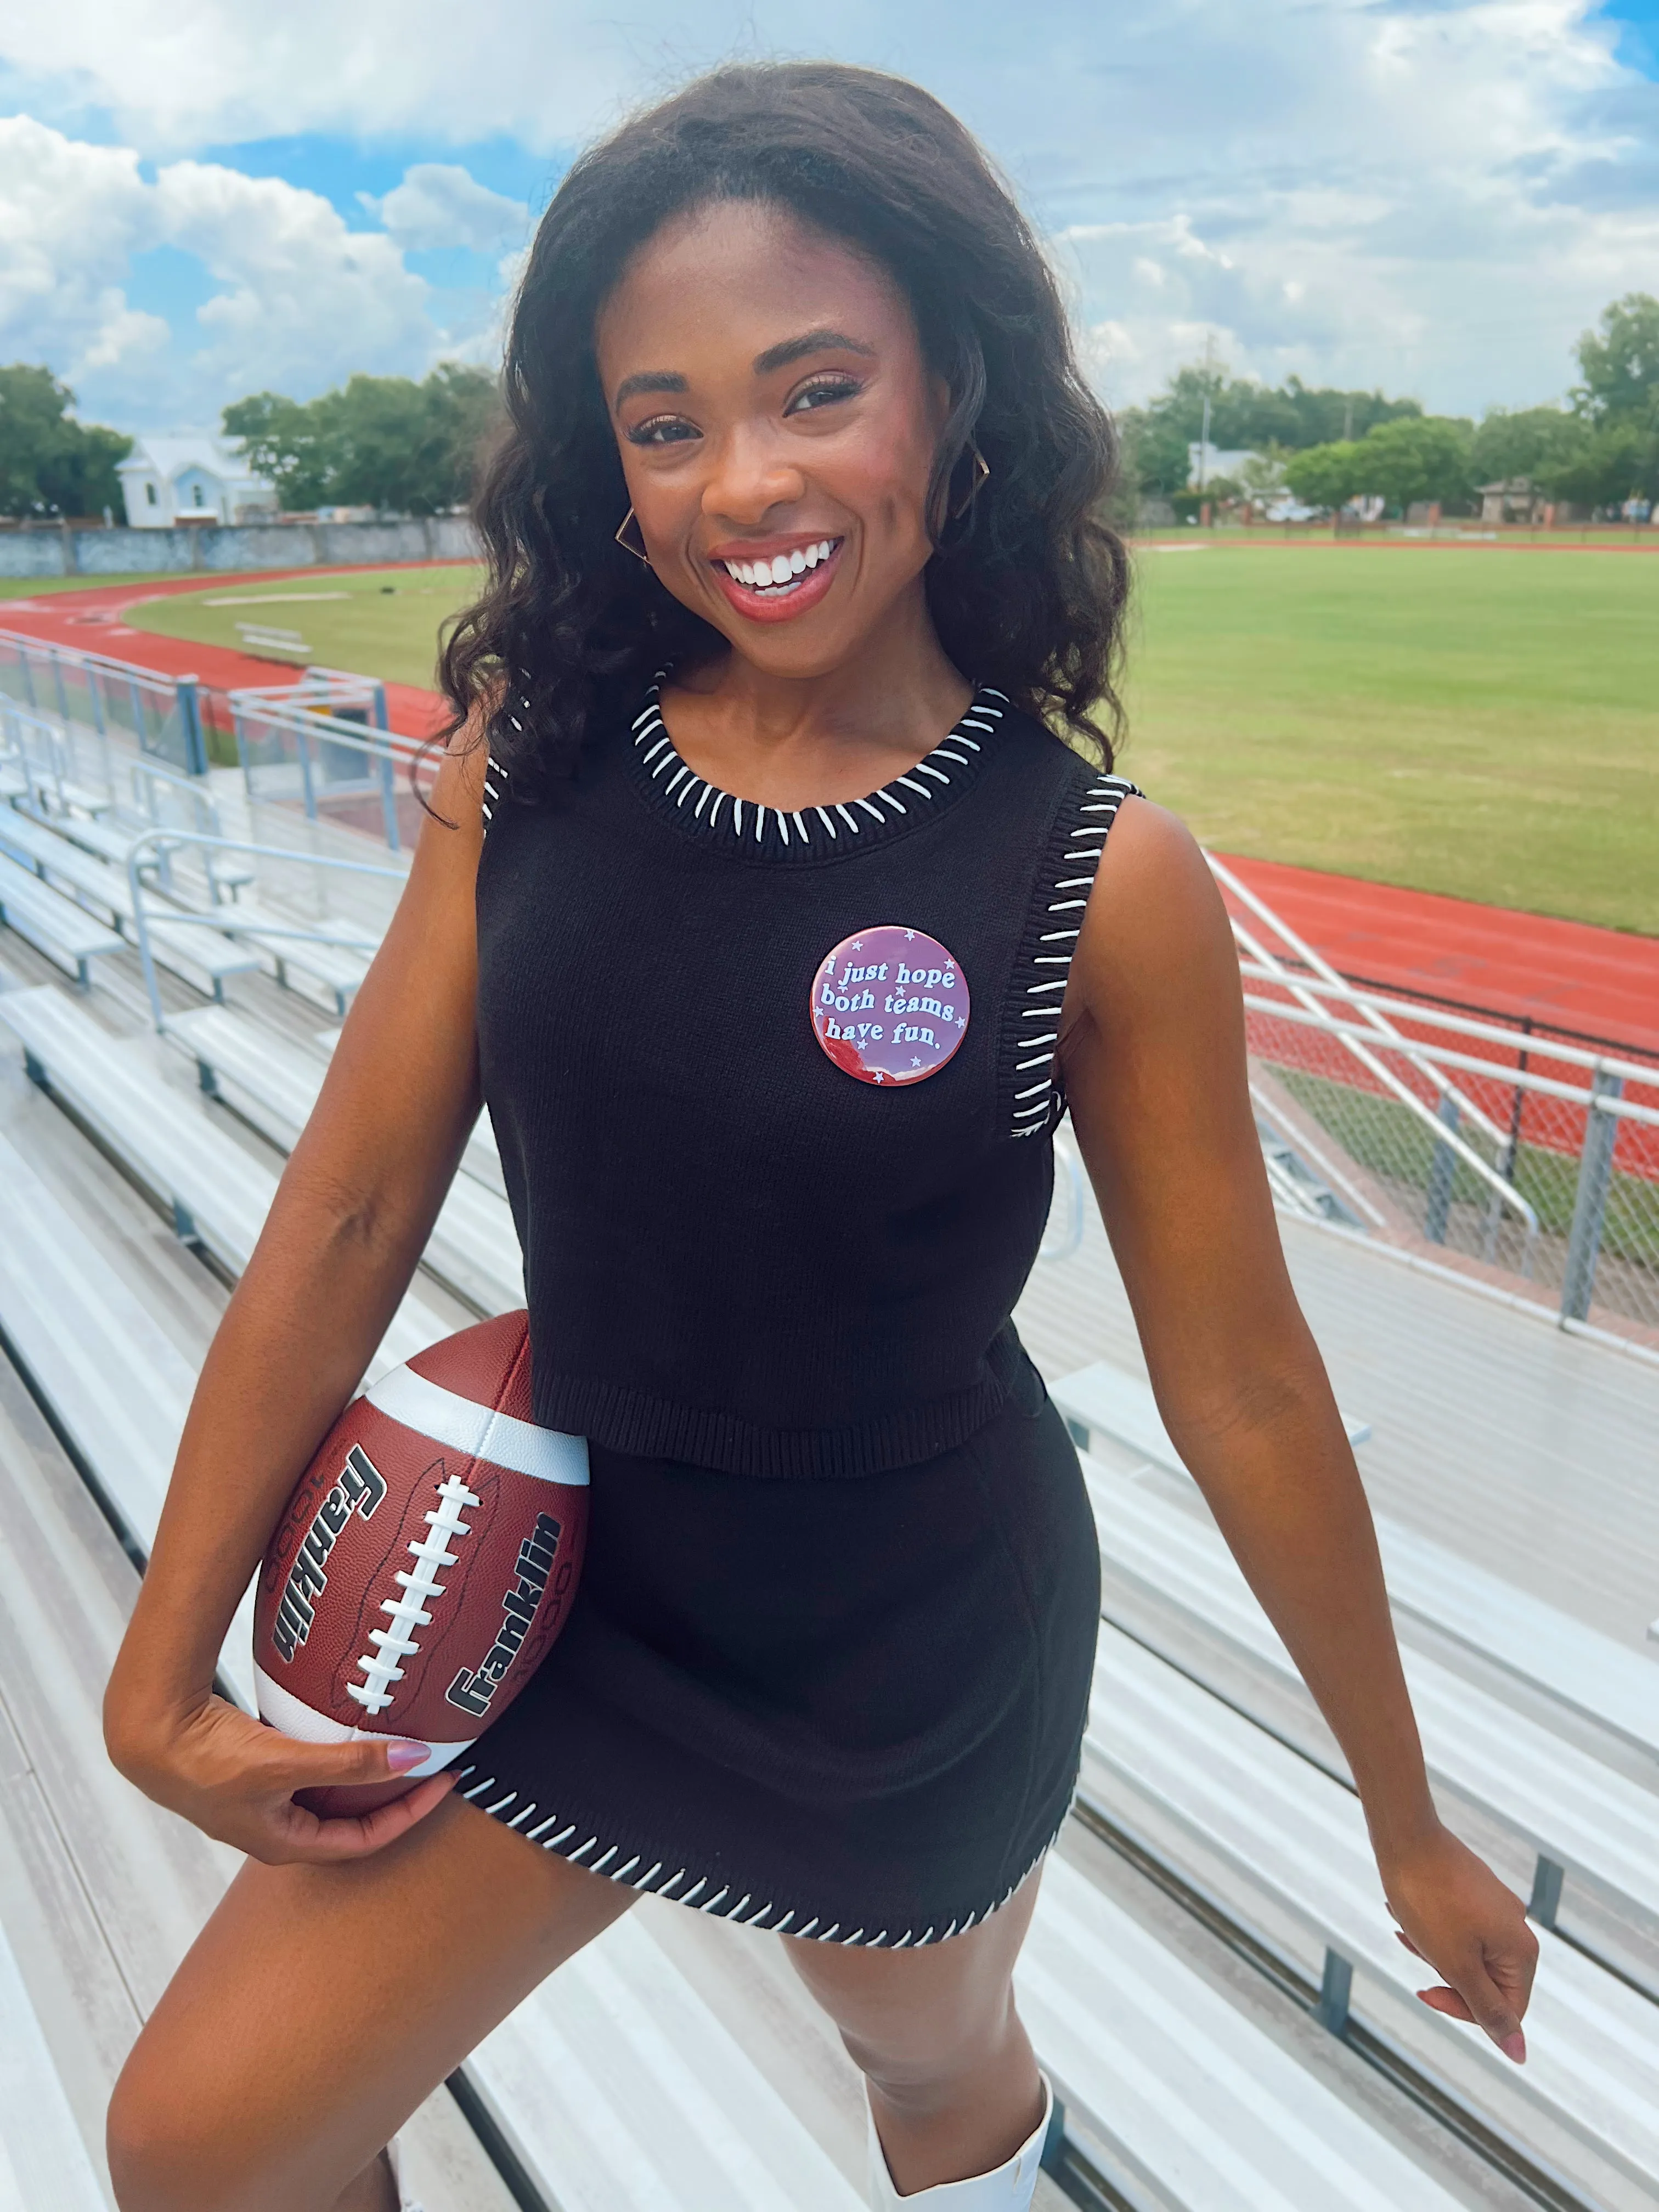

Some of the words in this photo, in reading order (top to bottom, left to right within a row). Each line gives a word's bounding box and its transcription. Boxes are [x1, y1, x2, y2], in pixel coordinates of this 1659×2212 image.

[825, 955, 837, 975] i
[838, 962, 889, 986] just
[895, 963, 955, 989] hope
[821, 983, 875, 1012] both
[884, 994, 955, 1022] teams
[825, 1018, 883, 1041] have
[891, 1022, 941, 1049] fun.
[273, 1442, 387, 1663] Franklin
[444, 1511, 561, 1718] Franklin
